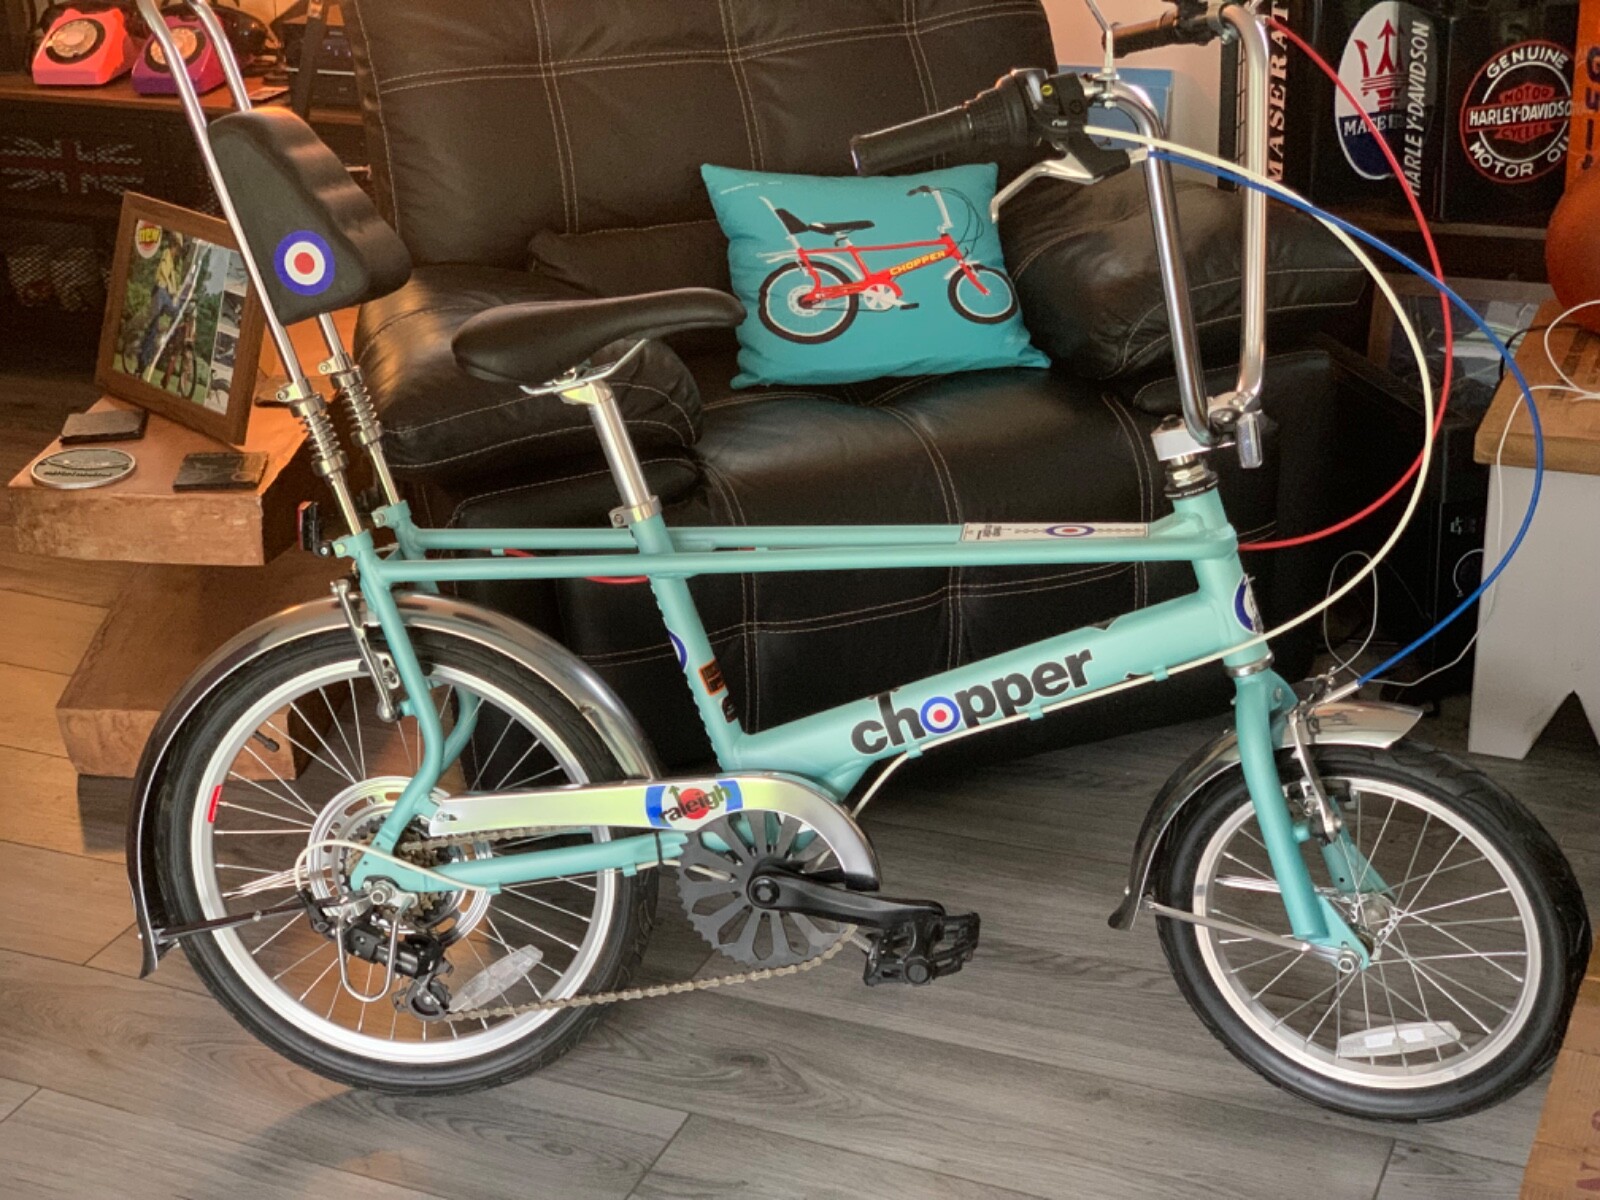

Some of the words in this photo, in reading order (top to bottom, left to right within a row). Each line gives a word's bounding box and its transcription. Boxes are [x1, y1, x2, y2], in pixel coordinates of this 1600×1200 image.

[1486, 46, 1569, 79] GENUINE
[1504, 84, 1551, 104] MOTOR
[1501, 122, 1551, 139] CYCLES
[1469, 141, 1534, 178] MOTOR
[889, 249, 946, 276] CHOPPER
[850, 649, 1093, 755] chopper
